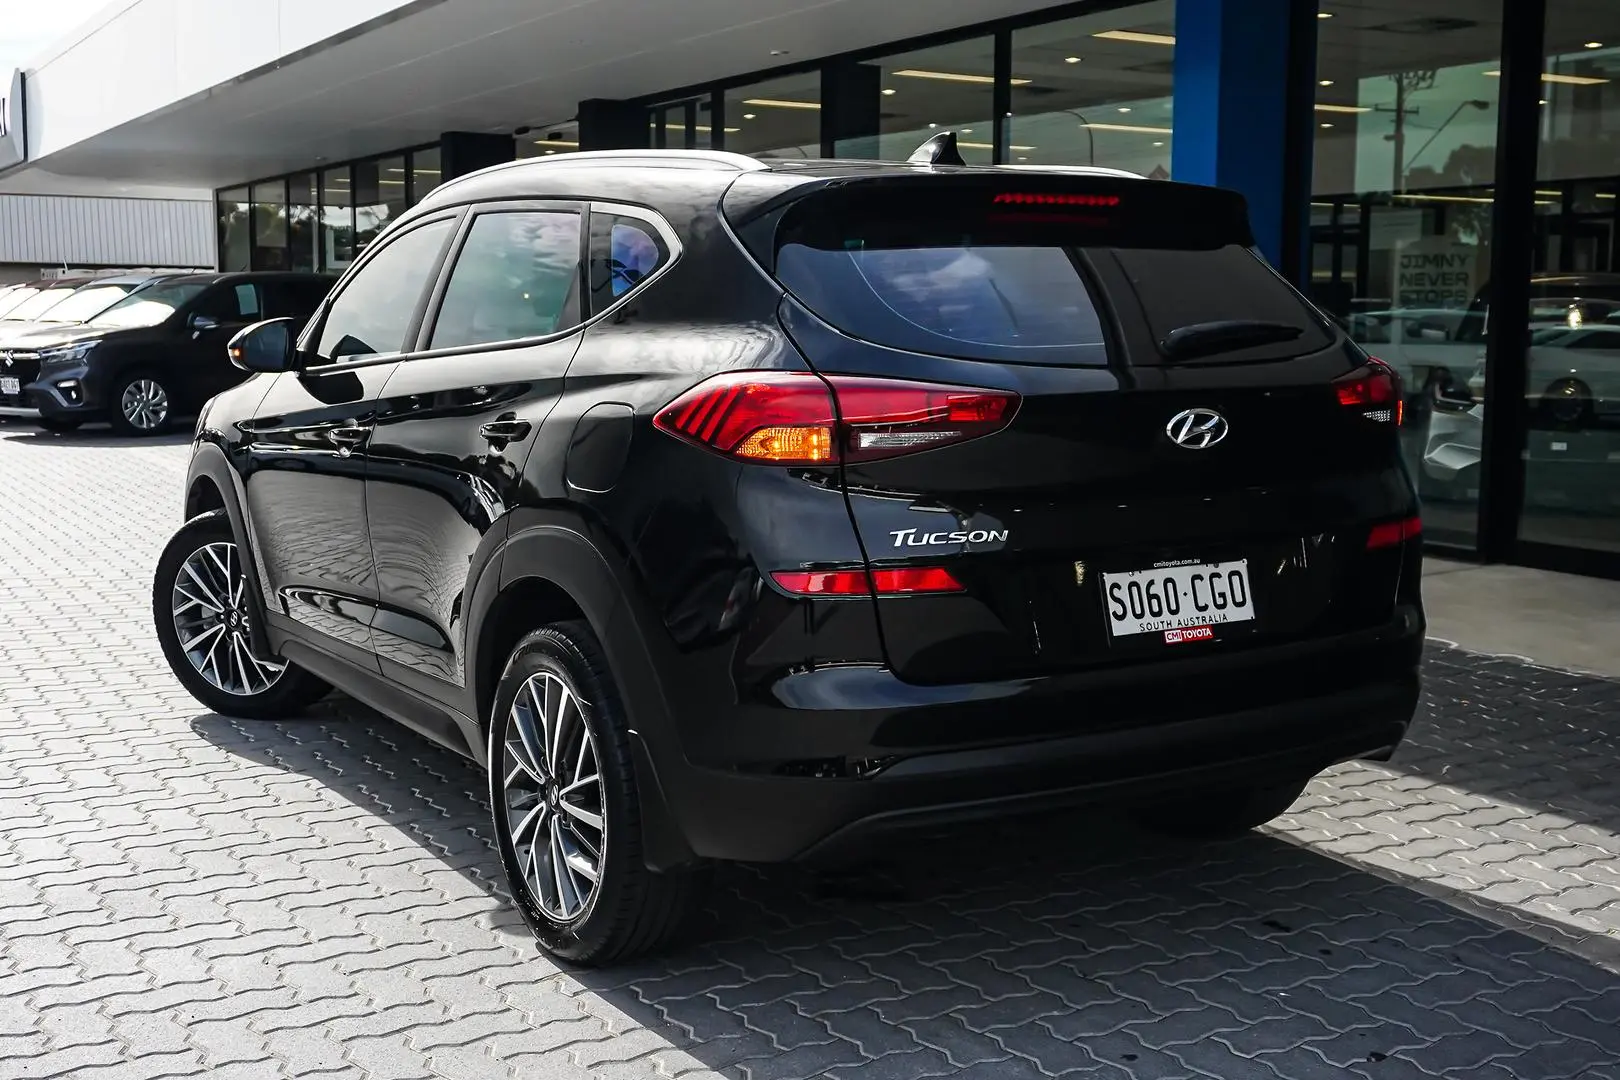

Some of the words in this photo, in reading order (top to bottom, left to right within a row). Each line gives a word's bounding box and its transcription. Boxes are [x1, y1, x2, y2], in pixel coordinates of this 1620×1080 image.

[1401, 254, 1469, 269] JIMNY
[1400, 272, 1469, 286] NEVER
[1153, 558, 1201, 568] cmitoyota.com.au
[1139, 618, 1173, 632] SOUTH
[1177, 613, 1228, 627] AUSTRALIA
[1182, 627, 1212, 639] TOYOTA
